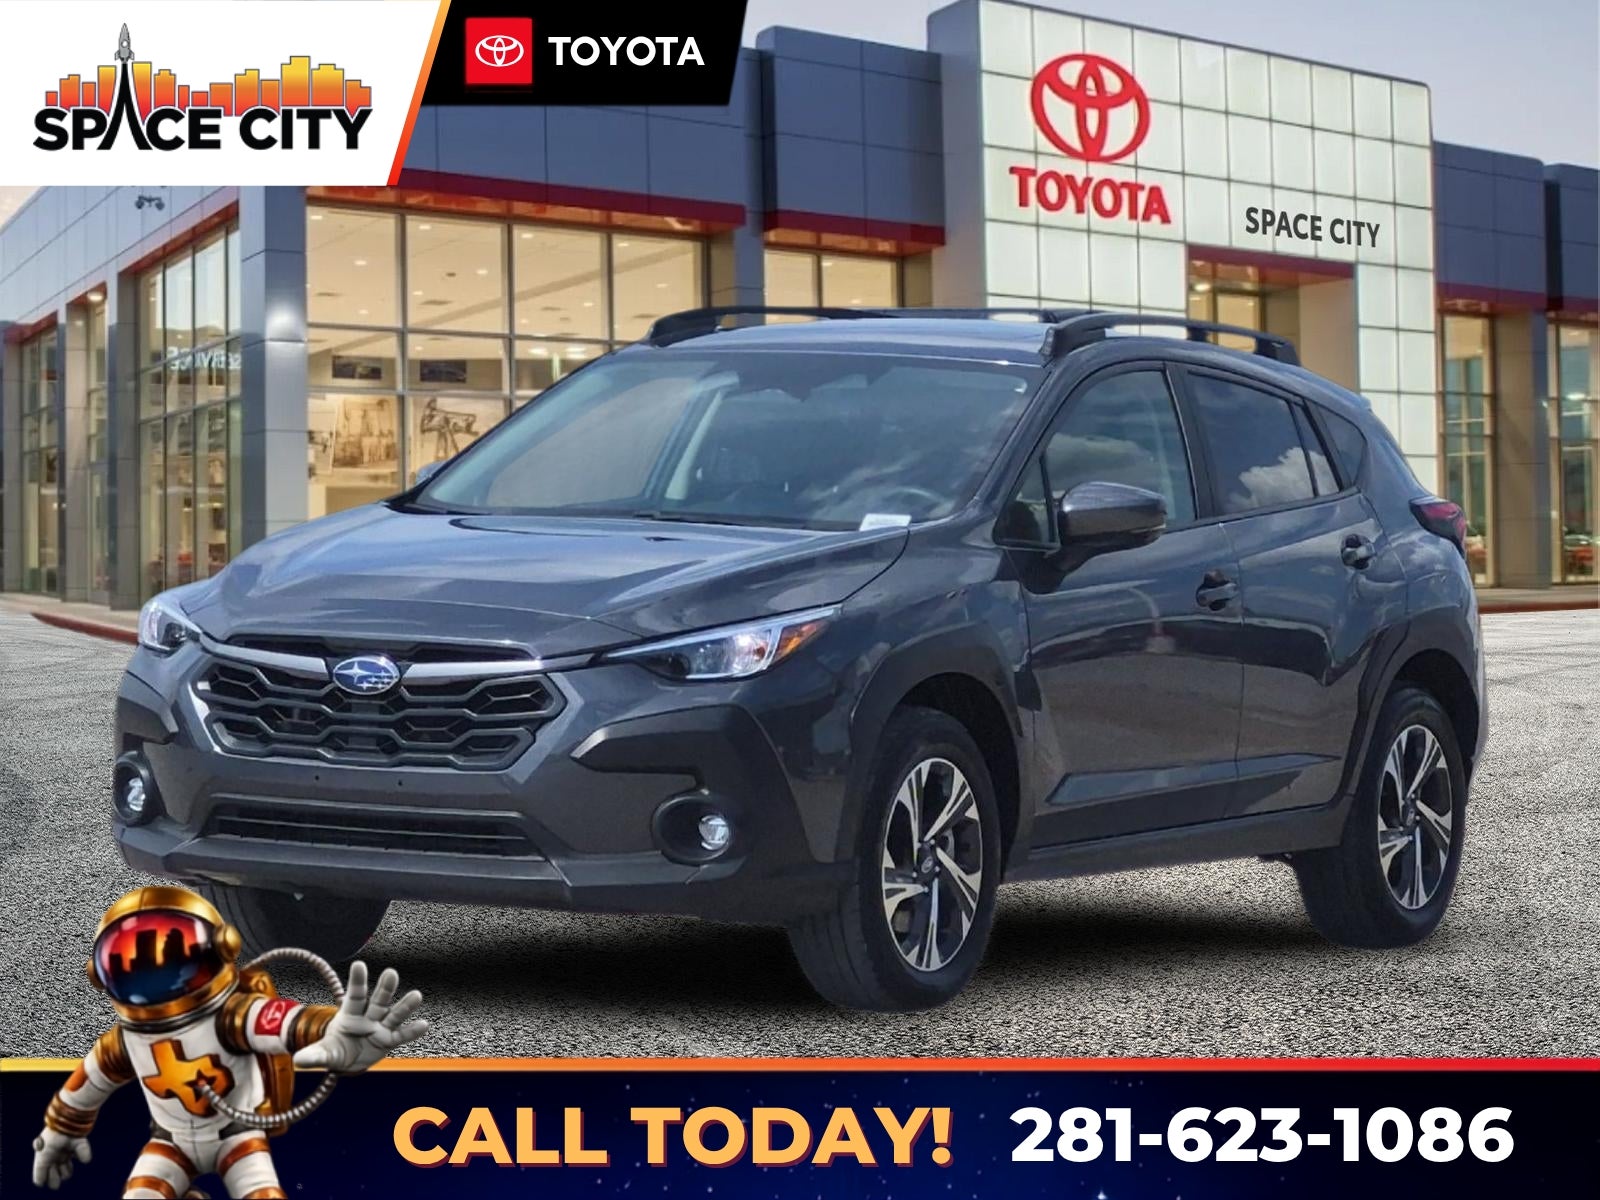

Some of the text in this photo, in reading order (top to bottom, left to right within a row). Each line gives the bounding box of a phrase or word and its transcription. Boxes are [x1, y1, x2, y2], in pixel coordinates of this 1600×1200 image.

[1009, 166, 1171, 224] TOYOTA
[1245, 206, 1381, 248] SPACE CITY
